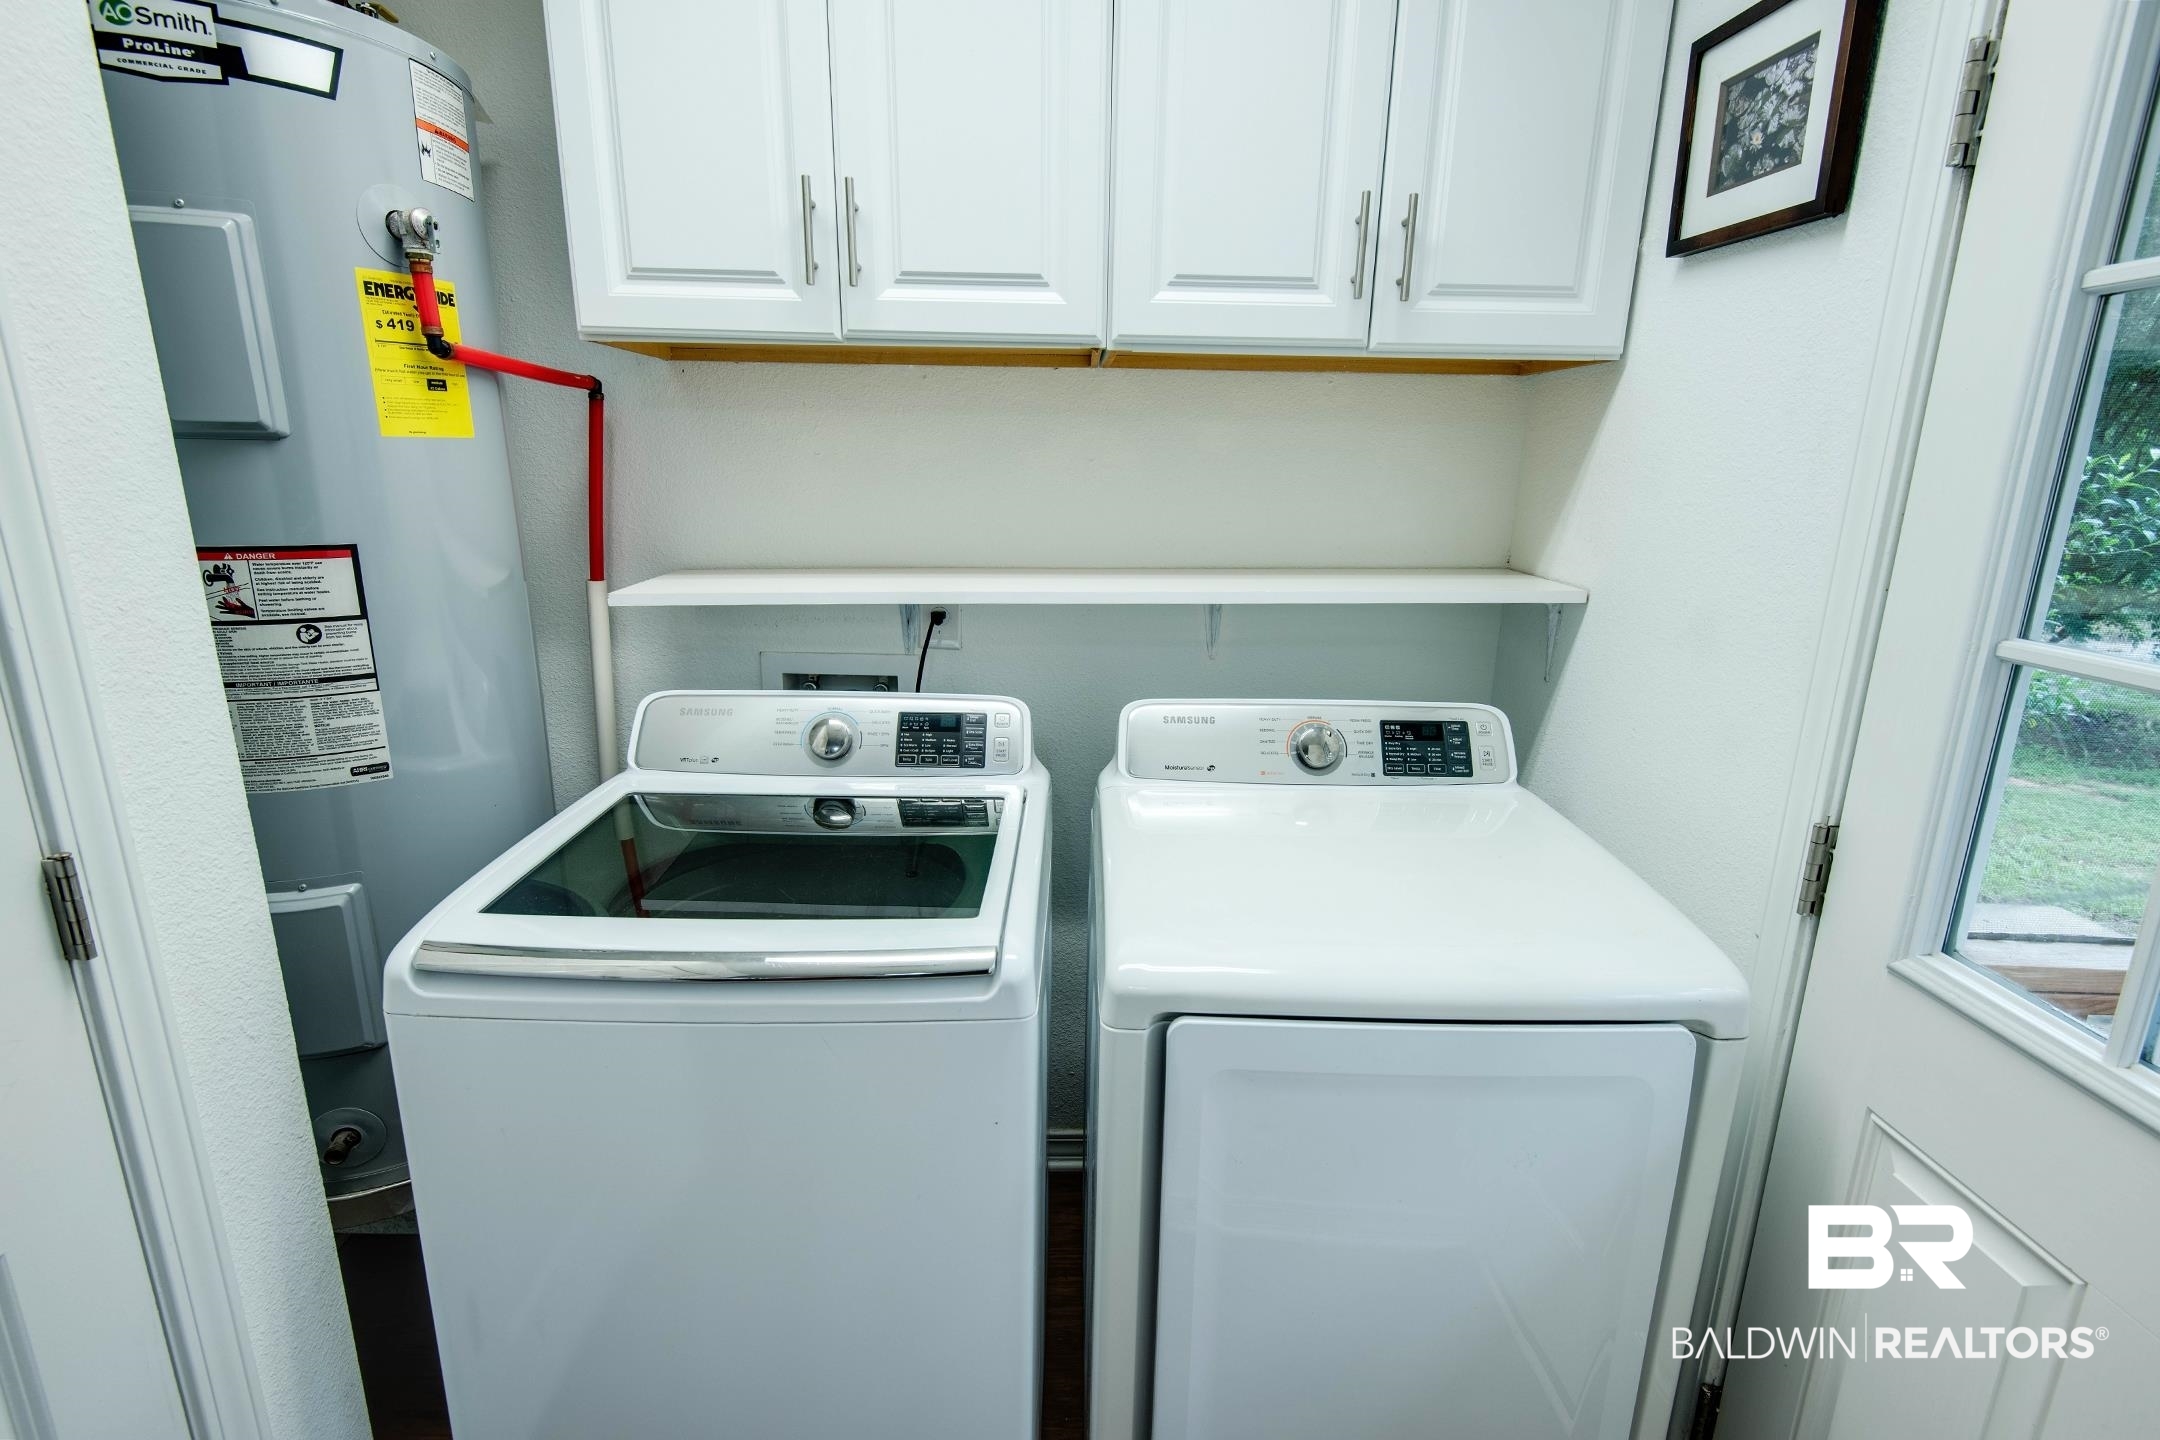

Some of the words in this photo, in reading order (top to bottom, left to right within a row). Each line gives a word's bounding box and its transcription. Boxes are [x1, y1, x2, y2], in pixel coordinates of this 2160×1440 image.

[134, 6, 208, 35] Smith
[122, 37, 193, 57] ProLine
[117, 57, 174, 70] COMMERCIAL
[177, 64, 207, 75] GRADE
[376, 320, 383, 328] $
[387, 318, 414, 331] 419
[680, 708, 734, 716] SAMSUNG
[1162, 715, 1216, 724] SAMSUNG
